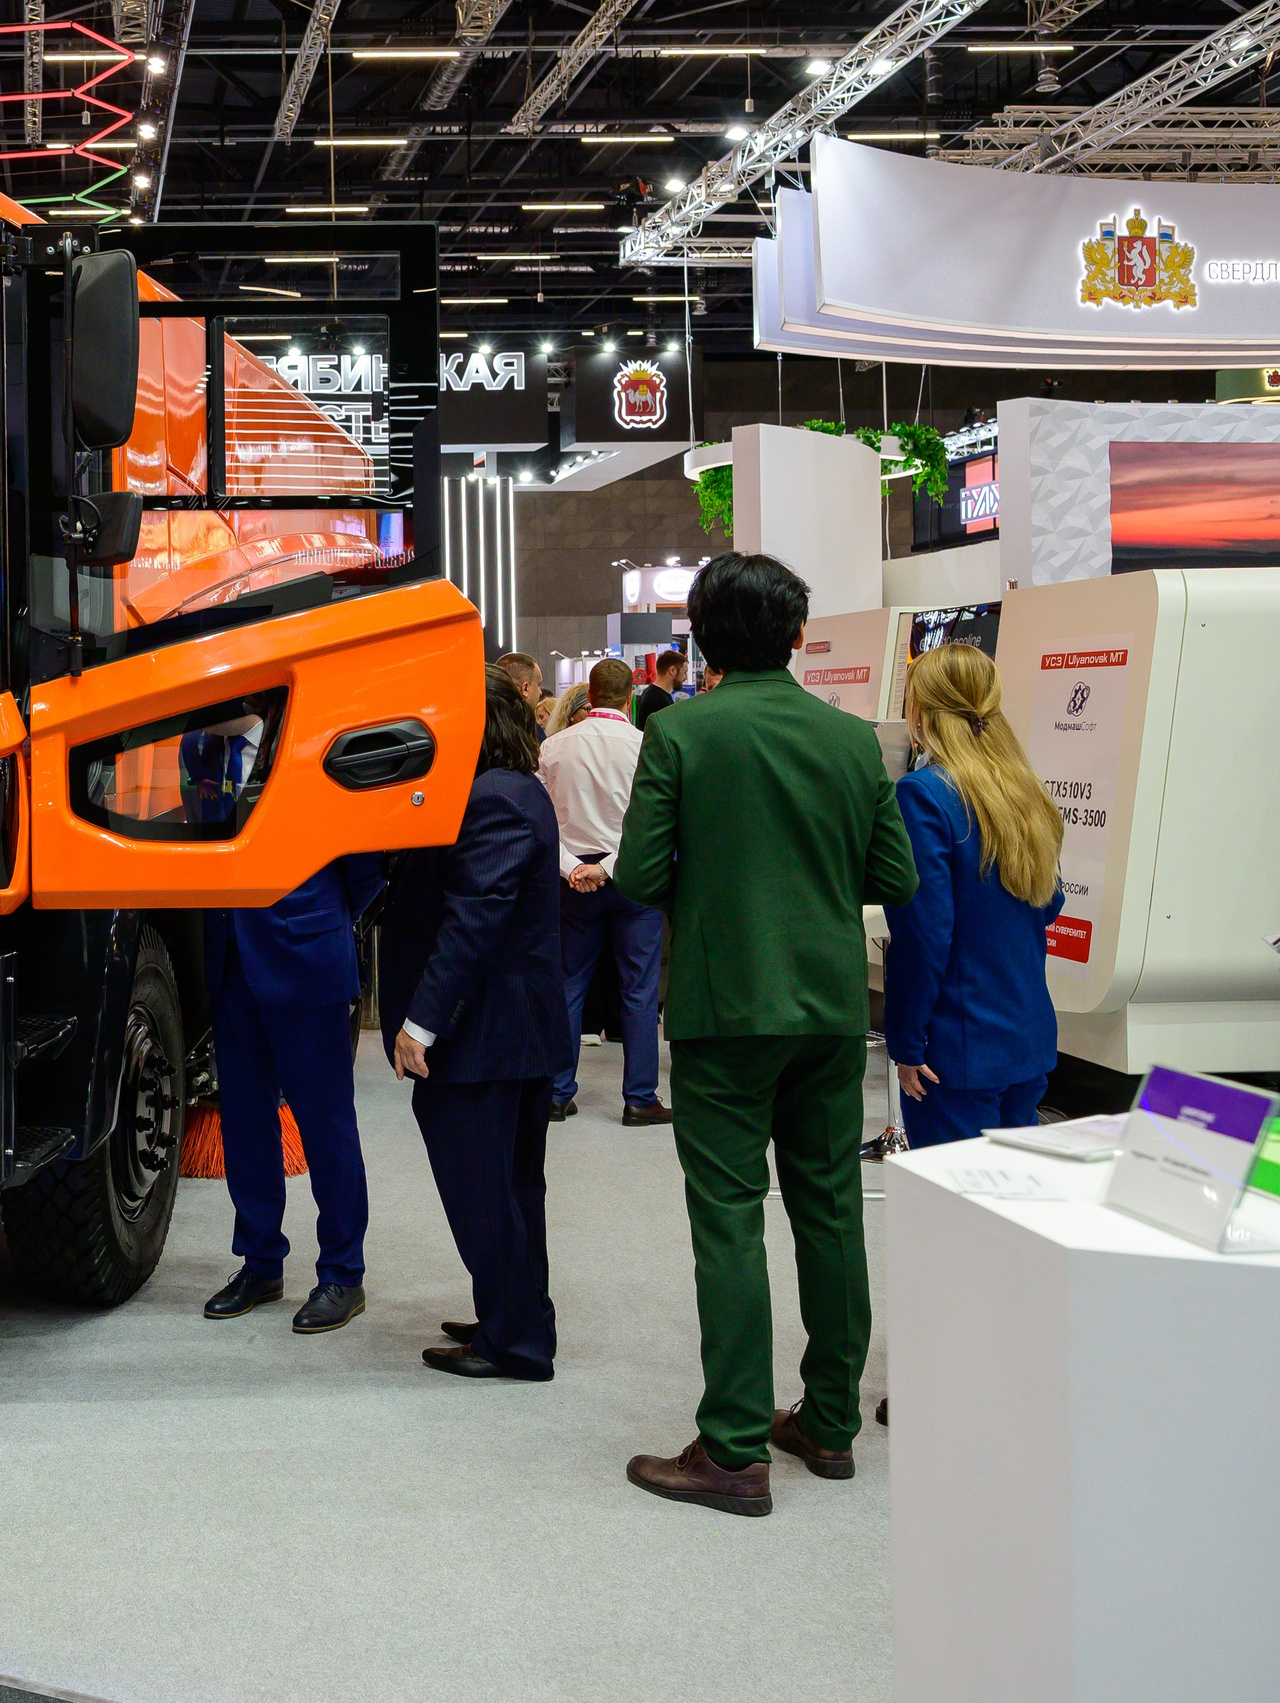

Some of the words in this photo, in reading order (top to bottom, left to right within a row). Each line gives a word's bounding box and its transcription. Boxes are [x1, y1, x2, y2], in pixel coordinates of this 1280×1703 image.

[1208, 262, 1278, 283] СВЕРДЛ
[1068, 653, 1108, 667] Ulyanovsk
[1109, 652, 1124, 663] MT
[824, 670, 855, 684] Ulyanovsk
[1054, 721, 1097, 733] МодмашСофт
